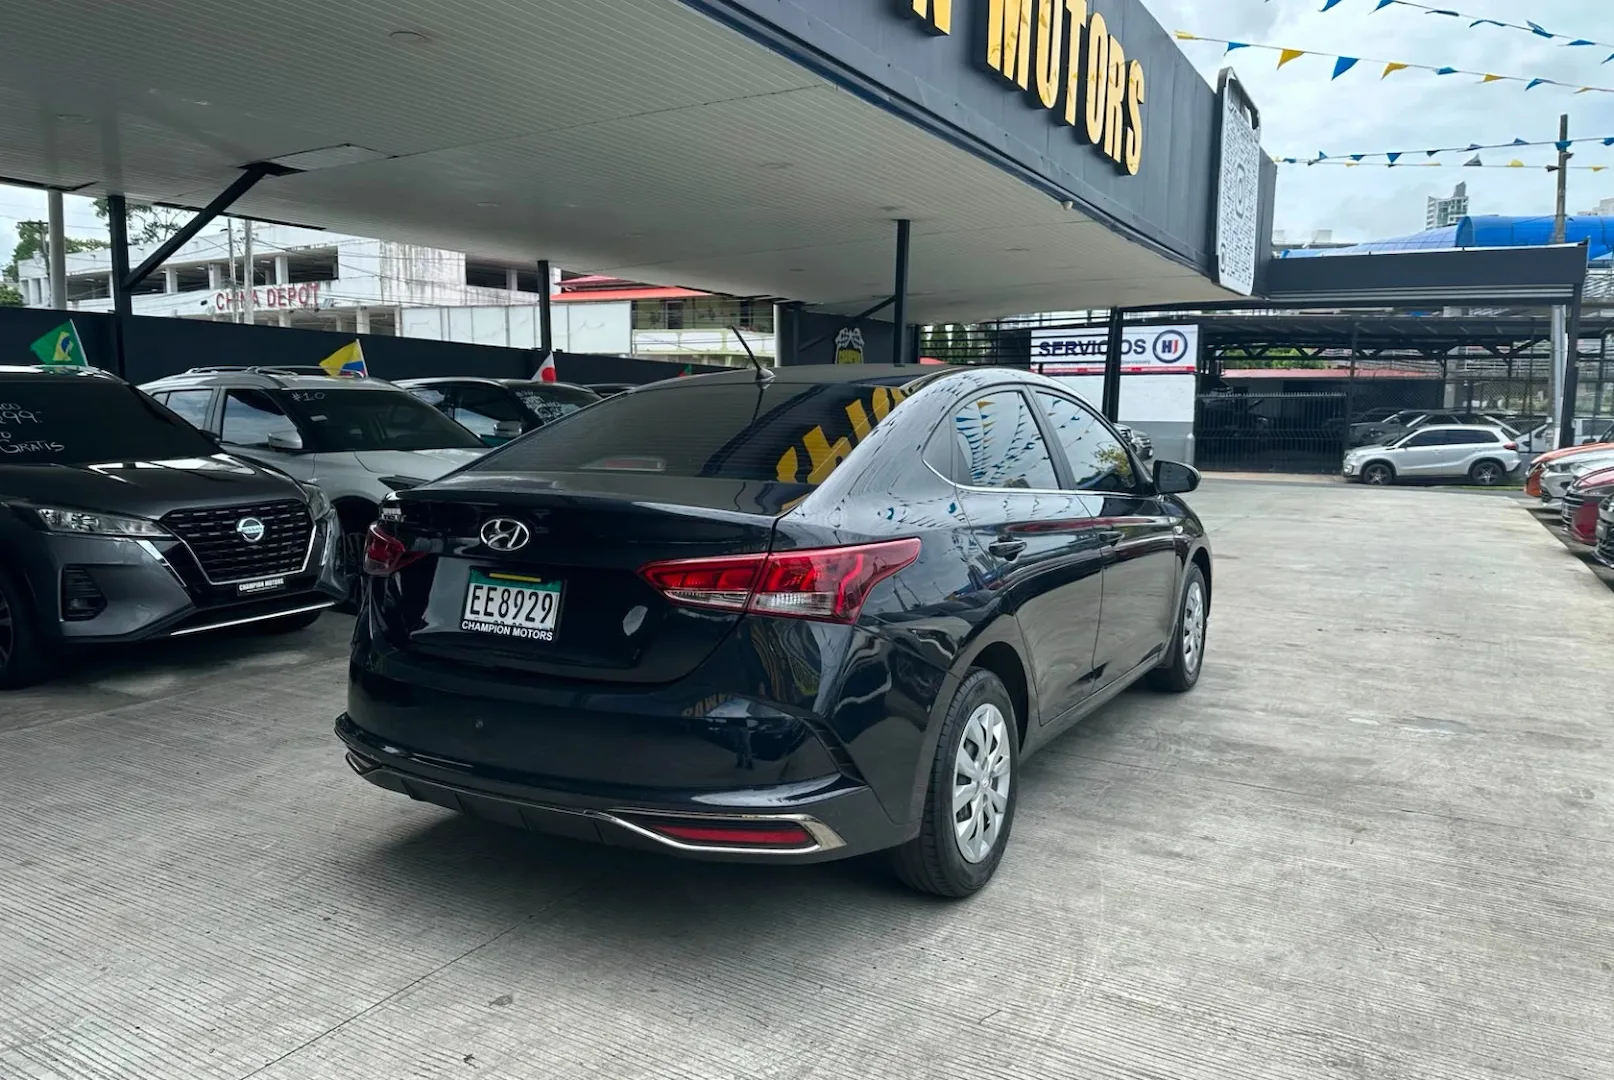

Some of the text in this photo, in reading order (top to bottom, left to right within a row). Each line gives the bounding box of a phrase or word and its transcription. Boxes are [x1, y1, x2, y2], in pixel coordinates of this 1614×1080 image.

[987, 0, 1145, 176] MOTORS
[266, 282, 320, 308] DEPOT
[1039, 338, 1147, 356] SERVICOS
[470, 584, 554, 624] EE8929
[461, 619, 511, 636] CHAMPION
[512, 626, 553, 642] MOTORS
